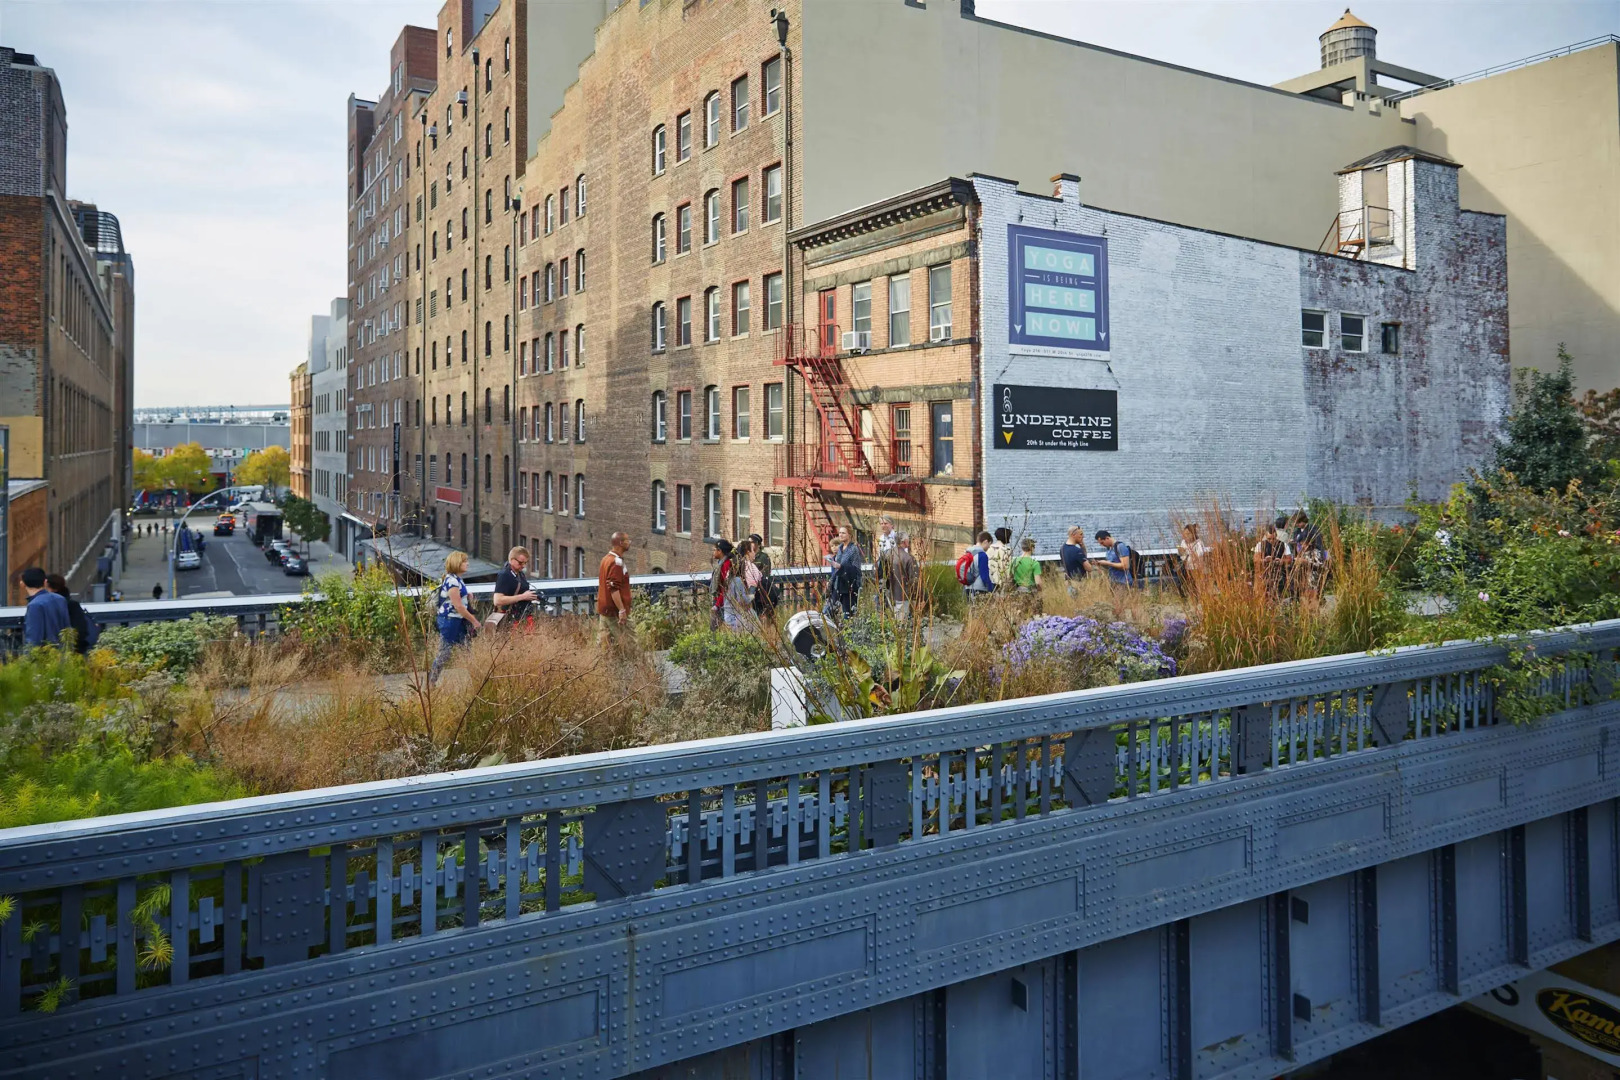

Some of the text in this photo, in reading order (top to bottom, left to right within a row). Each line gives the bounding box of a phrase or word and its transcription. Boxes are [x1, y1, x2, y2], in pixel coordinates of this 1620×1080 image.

[1029, 249, 1091, 271] YOGA
[1043, 274, 1078, 286] IS BEING
[1031, 288, 1088, 308] HERE
[1031, 318, 1089, 337] NOW!
[1001, 414, 1112, 427] UNDERLINE
[1052, 429, 1112, 440] COFFEE
[1067, 440, 1079, 448] High
